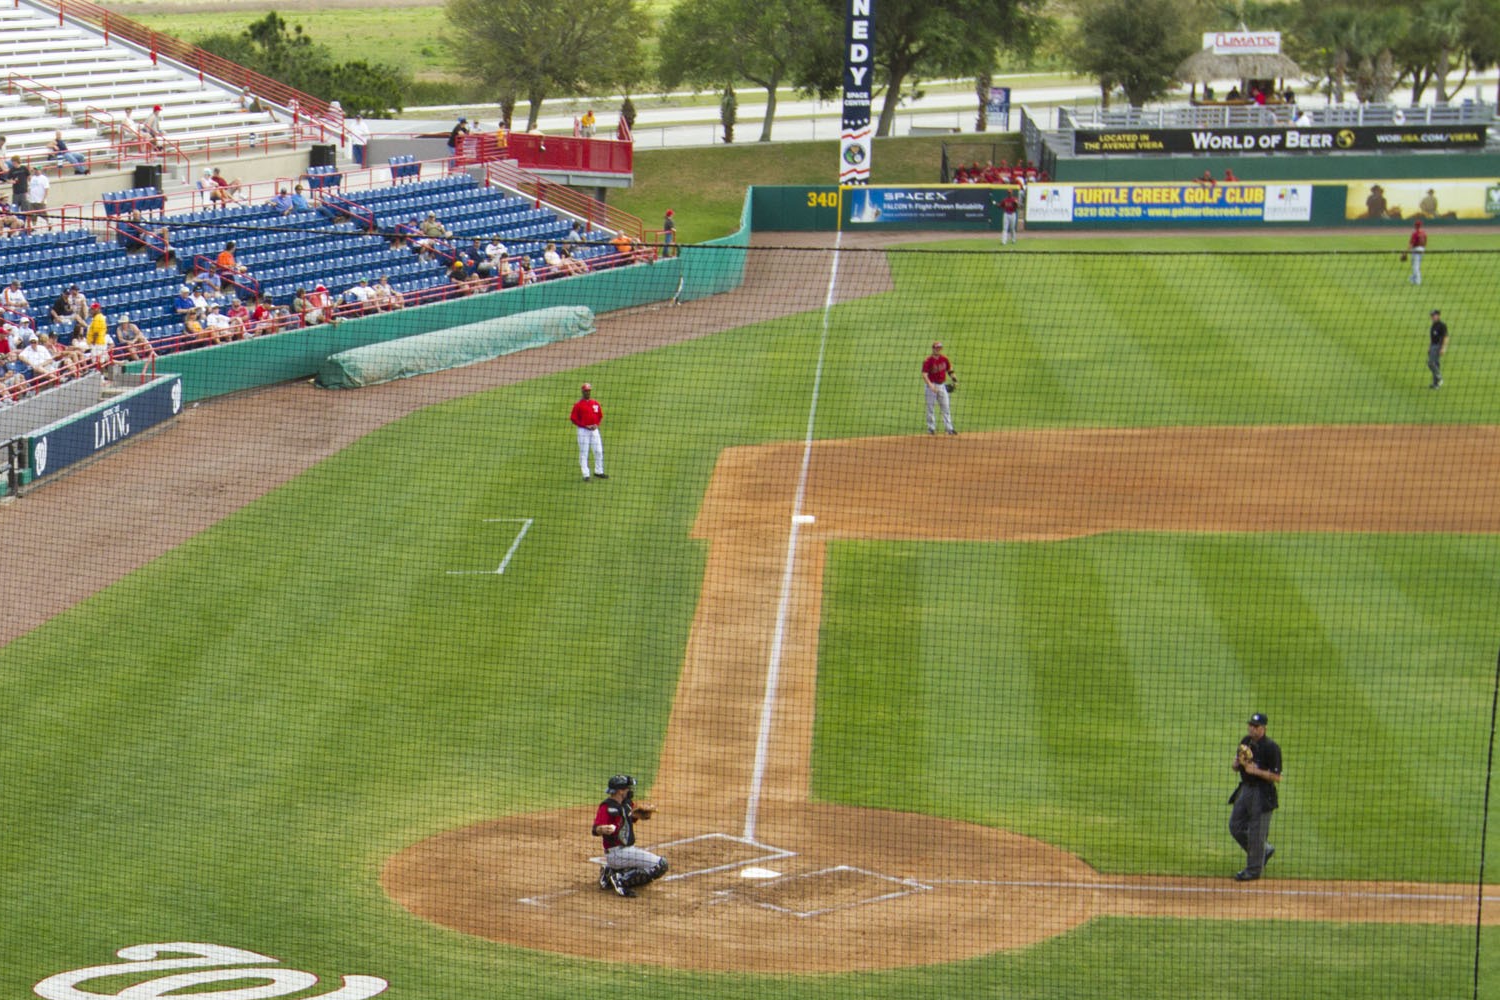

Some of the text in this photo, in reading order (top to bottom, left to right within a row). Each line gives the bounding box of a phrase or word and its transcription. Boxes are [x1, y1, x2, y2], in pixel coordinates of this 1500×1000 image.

[1099, 133, 1150, 142] LOCATED IN
[1192, 130, 1333, 150] WORLD OF BEER
[1084, 141, 1164, 150] THE AVENUE VIERA
[807, 192, 837, 207] 340
[883, 192, 947, 201] SPACEX
[1075, 187, 1265, 204] TURTLE CREEK GOLF CLUB
[94, 408, 130, 450] LIVING
